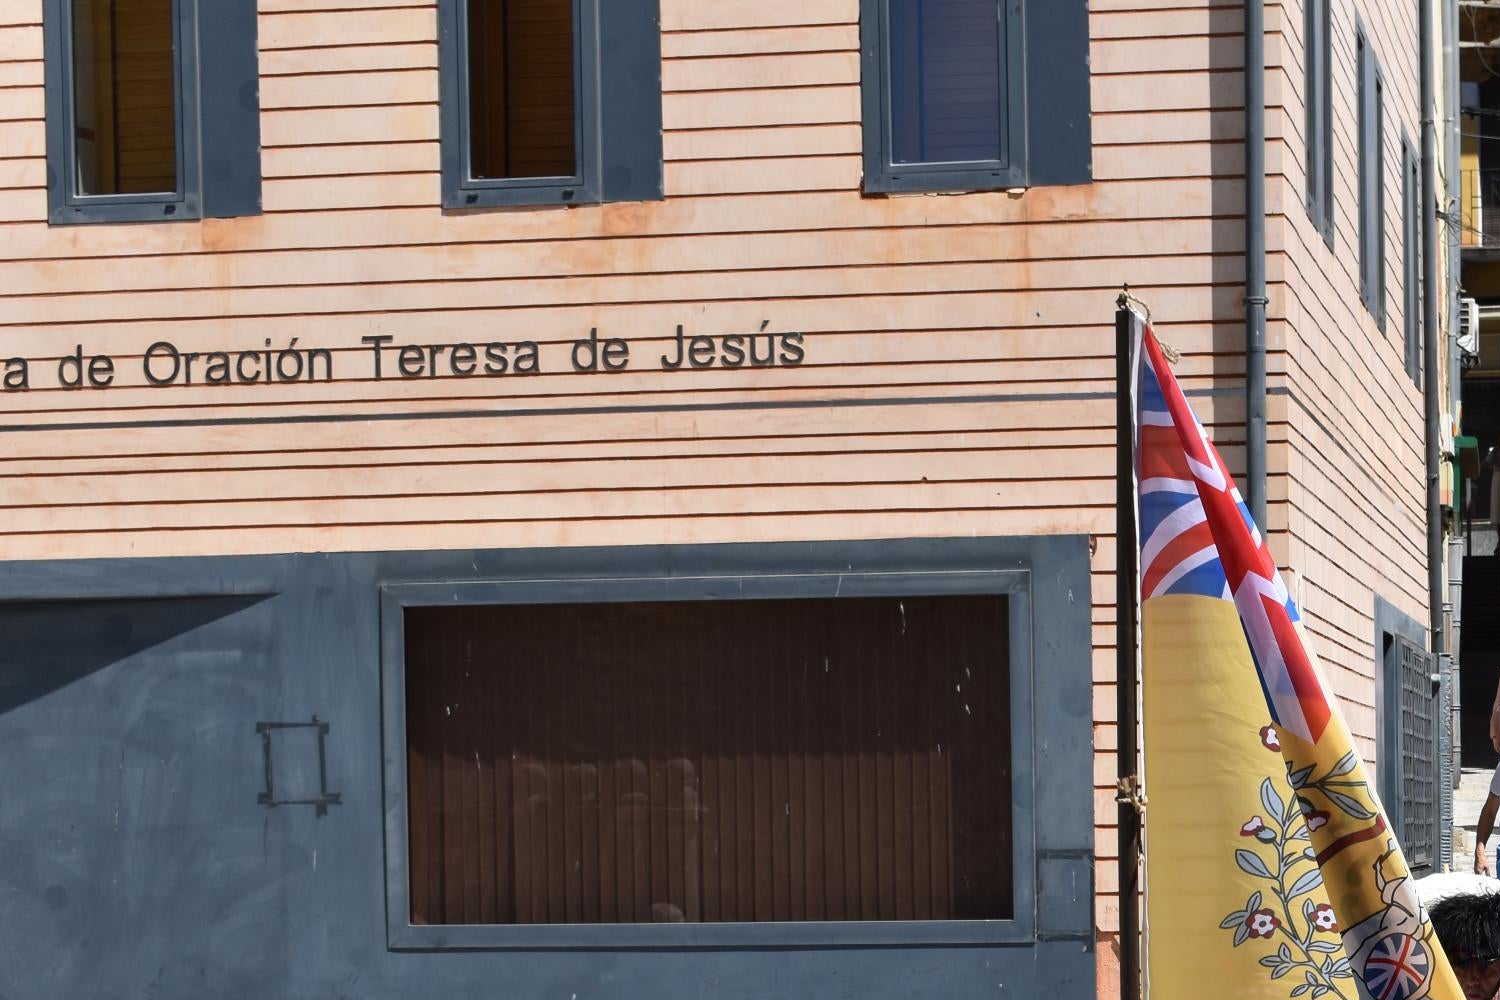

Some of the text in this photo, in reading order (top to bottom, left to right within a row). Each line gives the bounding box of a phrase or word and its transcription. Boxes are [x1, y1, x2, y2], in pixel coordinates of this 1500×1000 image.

[3, 319, 805, 390] a de Oración Teresa de Jesús
